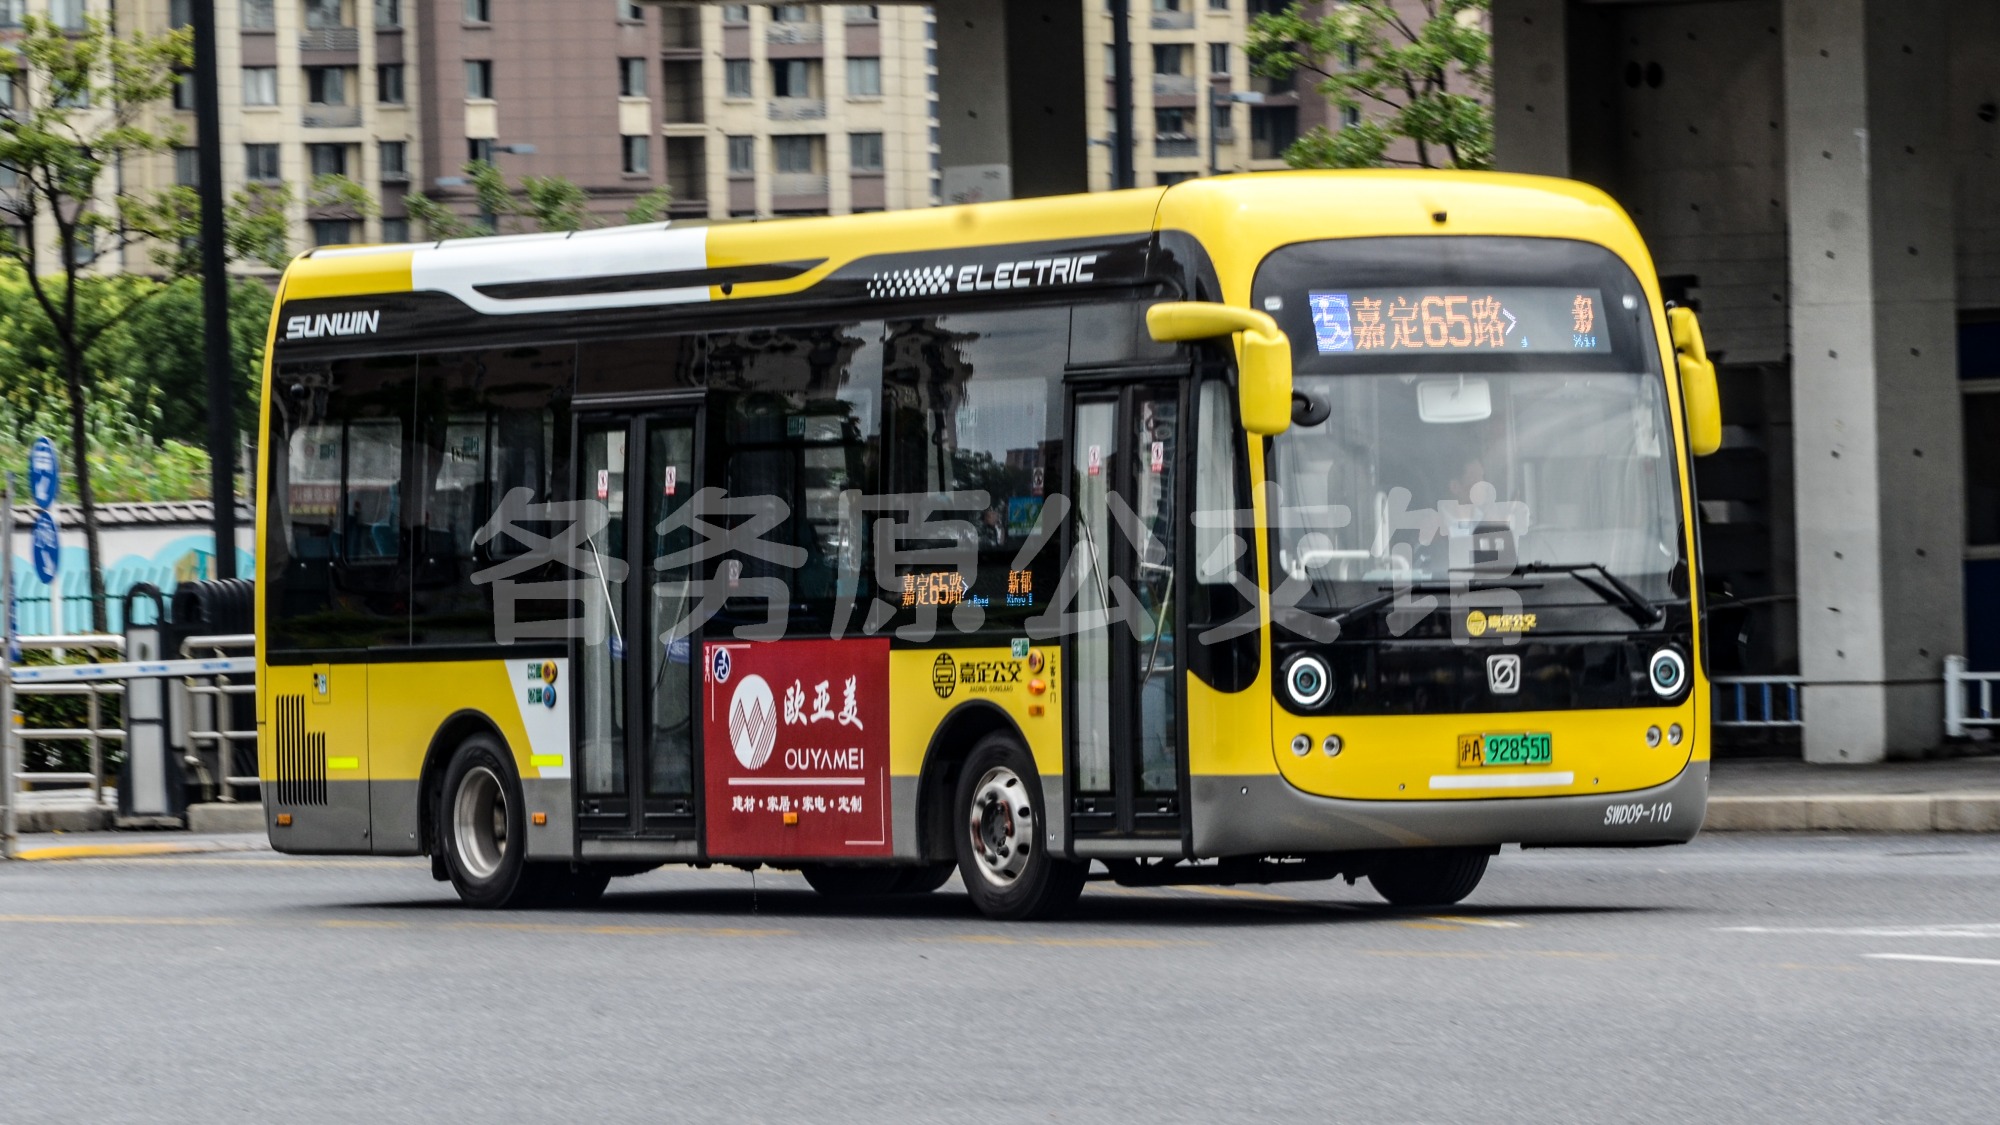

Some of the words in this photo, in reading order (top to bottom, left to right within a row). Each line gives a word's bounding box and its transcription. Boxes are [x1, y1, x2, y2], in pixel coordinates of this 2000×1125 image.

[957, 255, 1097, 292] ELECTRIC
[286, 310, 379, 339] SUNWIN
[1352, 295, 1504, 349] 嘉定65路
[902, 572, 963, 607] 嘉定65路
[960, 661, 1022, 683] 嘉定公交
[784, 675, 863, 731] 欧亚美
[785, 748, 864, 770] OUYAMEI
[1604, 802, 1672, 825] SWD09-110
